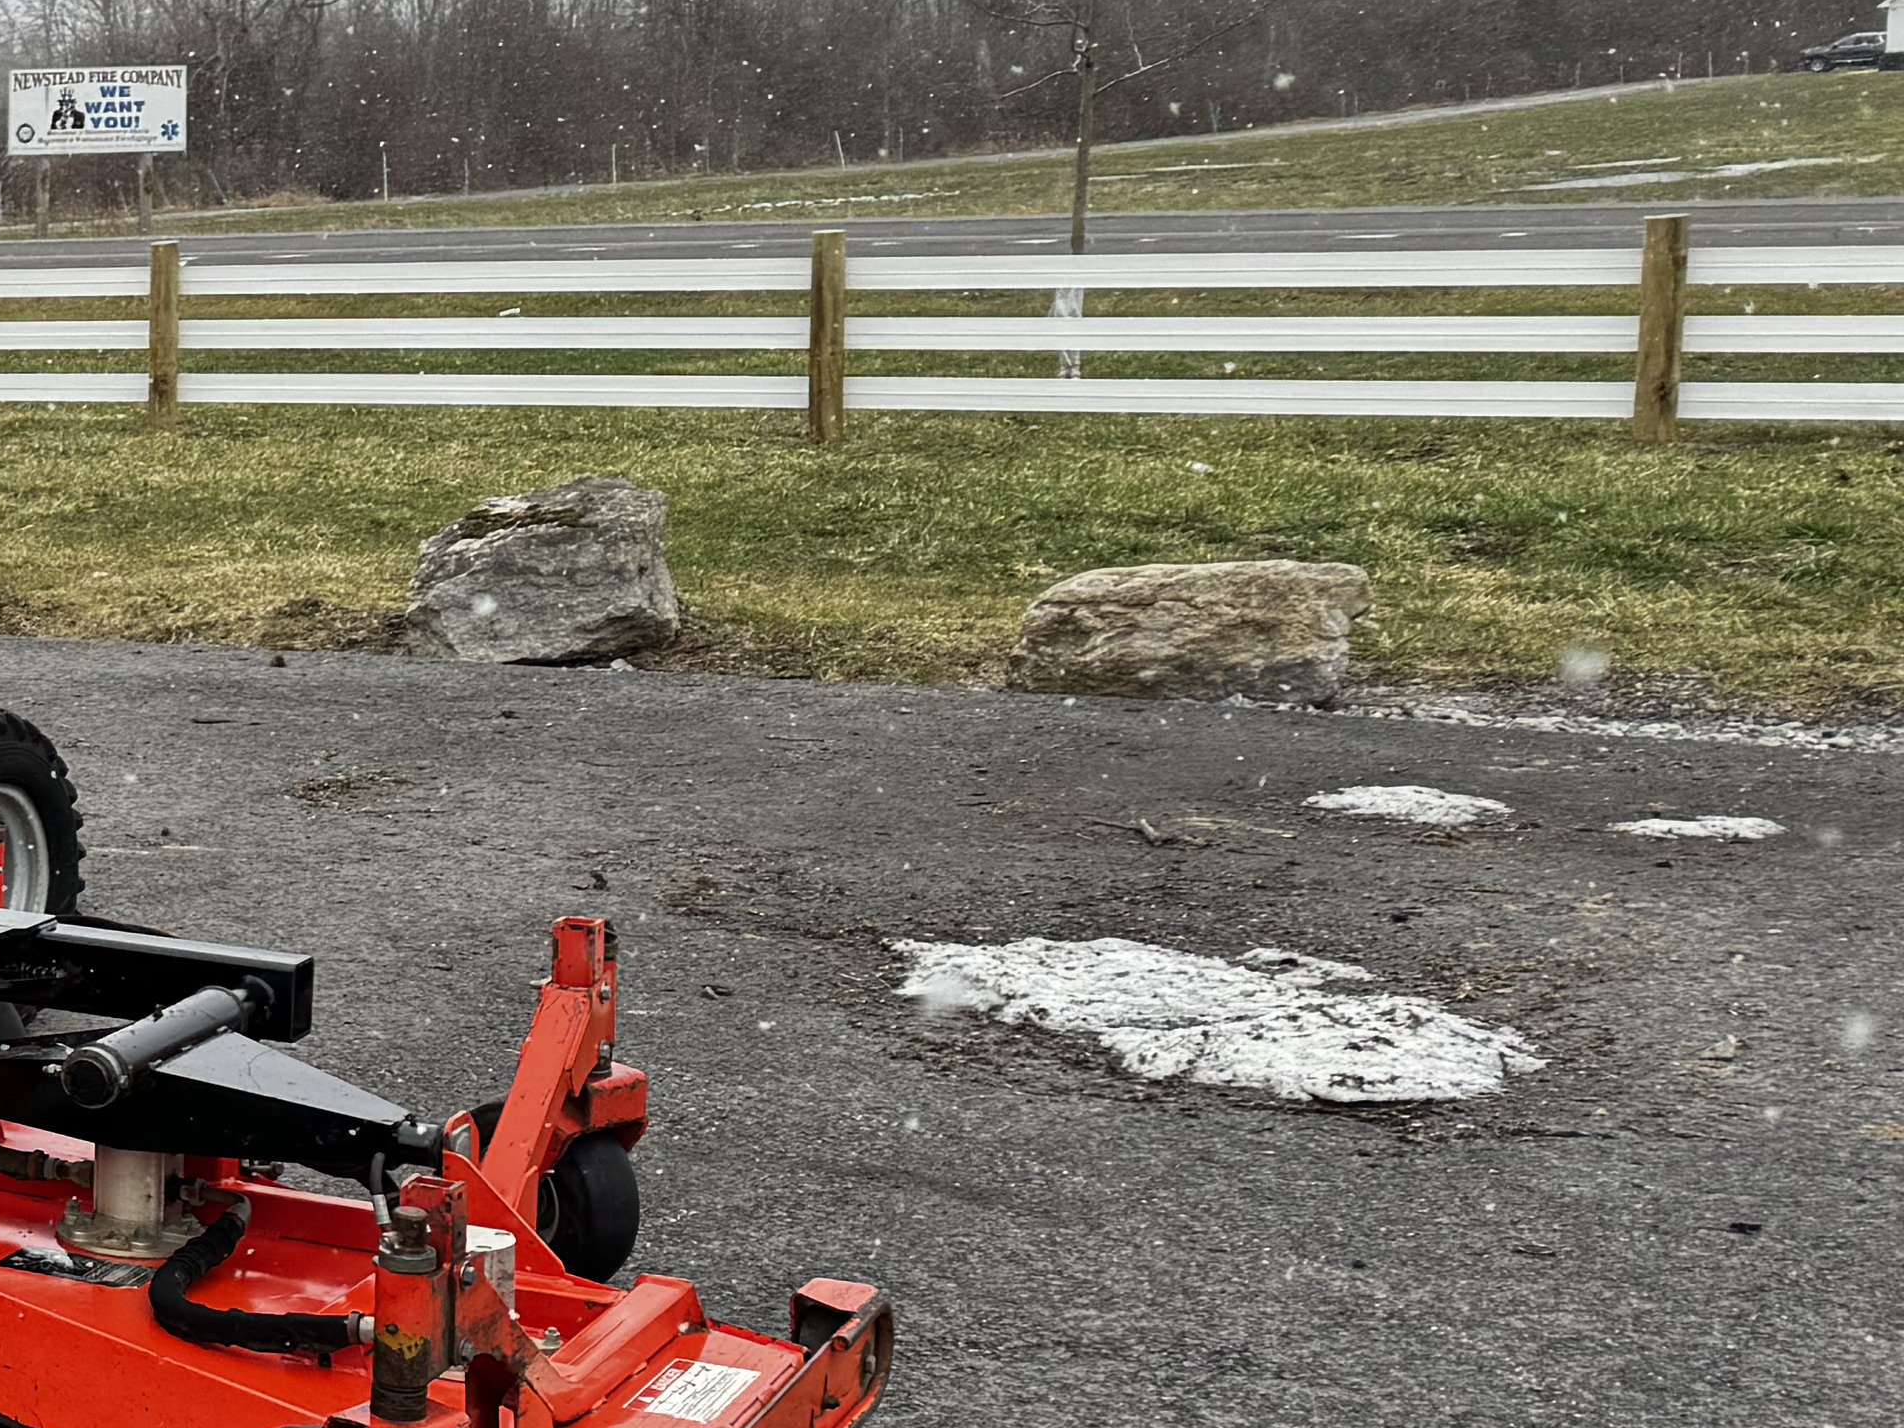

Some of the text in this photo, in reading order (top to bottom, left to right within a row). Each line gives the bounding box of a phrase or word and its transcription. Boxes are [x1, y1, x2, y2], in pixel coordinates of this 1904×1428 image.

[13, 70, 183, 92] NEWSTEAD FIRE COMPANY
[100, 86, 131, 98] WE
[84, 101, 145, 113] WANT
[90, 116, 140, 129] YOU!
